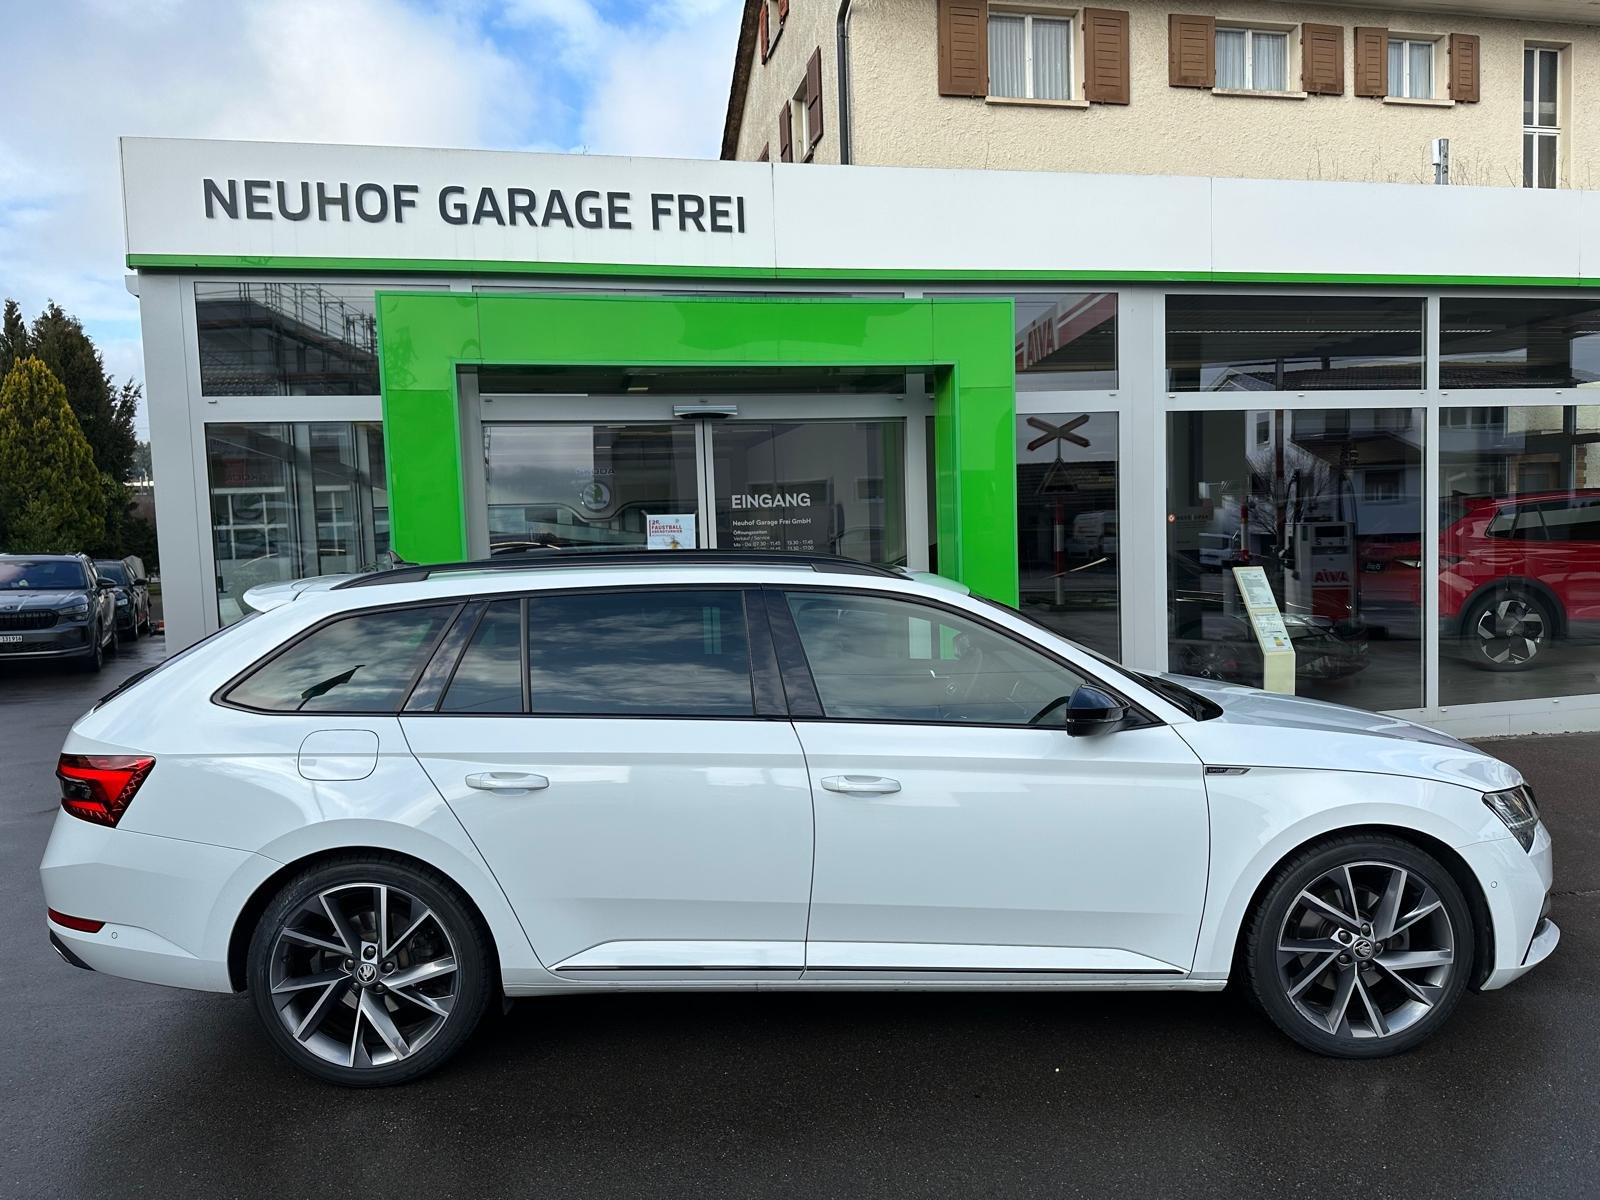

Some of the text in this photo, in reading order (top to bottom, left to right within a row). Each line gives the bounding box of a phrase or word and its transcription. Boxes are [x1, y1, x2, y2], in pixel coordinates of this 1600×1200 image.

[204, 179, 744, 233] NEUHOF GARAGE FREI
[731, 493, 811, 509] EINGANG
[756, 519, 778, 527] Garage
